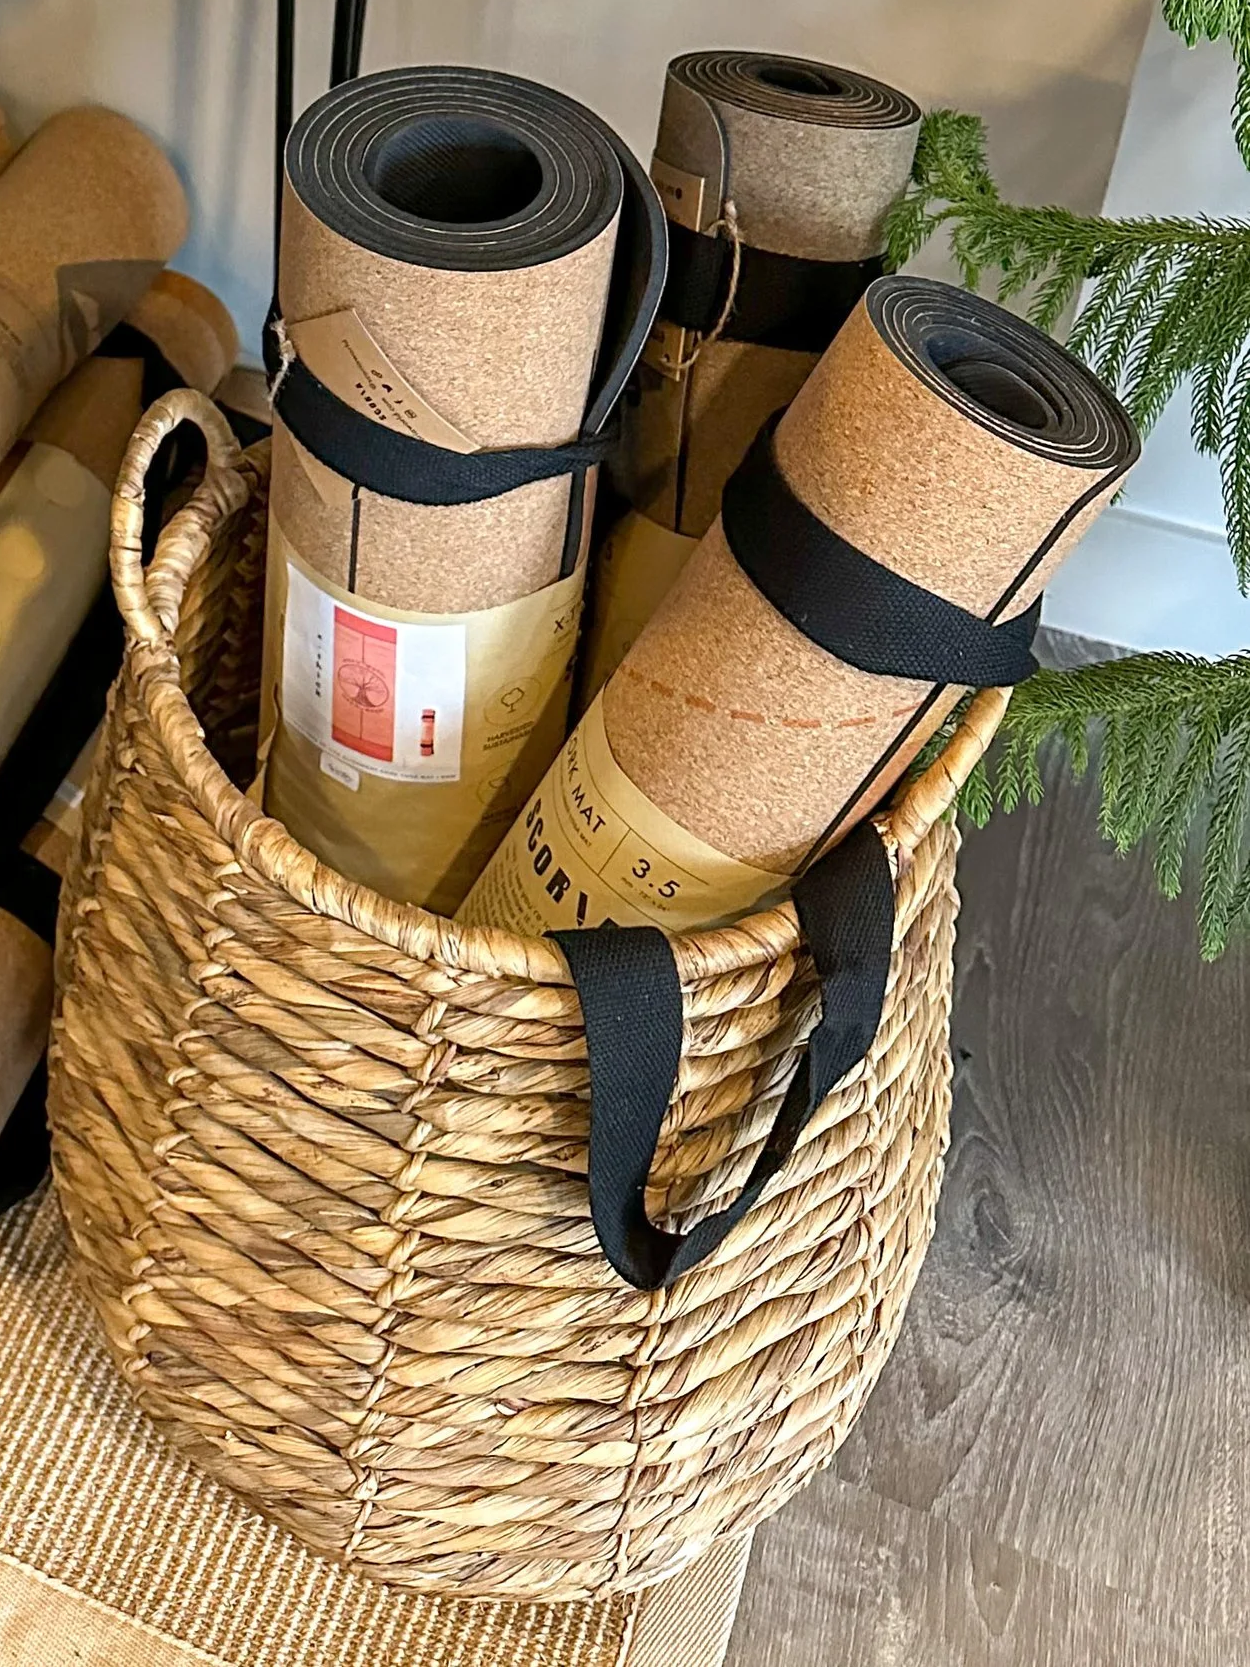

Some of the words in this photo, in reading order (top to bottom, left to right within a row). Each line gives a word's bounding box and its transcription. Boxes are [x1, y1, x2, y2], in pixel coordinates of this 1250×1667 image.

[566, 736, 579, 782] ORK
[572, 783, 606, 834] MAT
[526, 798, 618, 929] SCORI
[632, 858, 680, 898] 3.5
